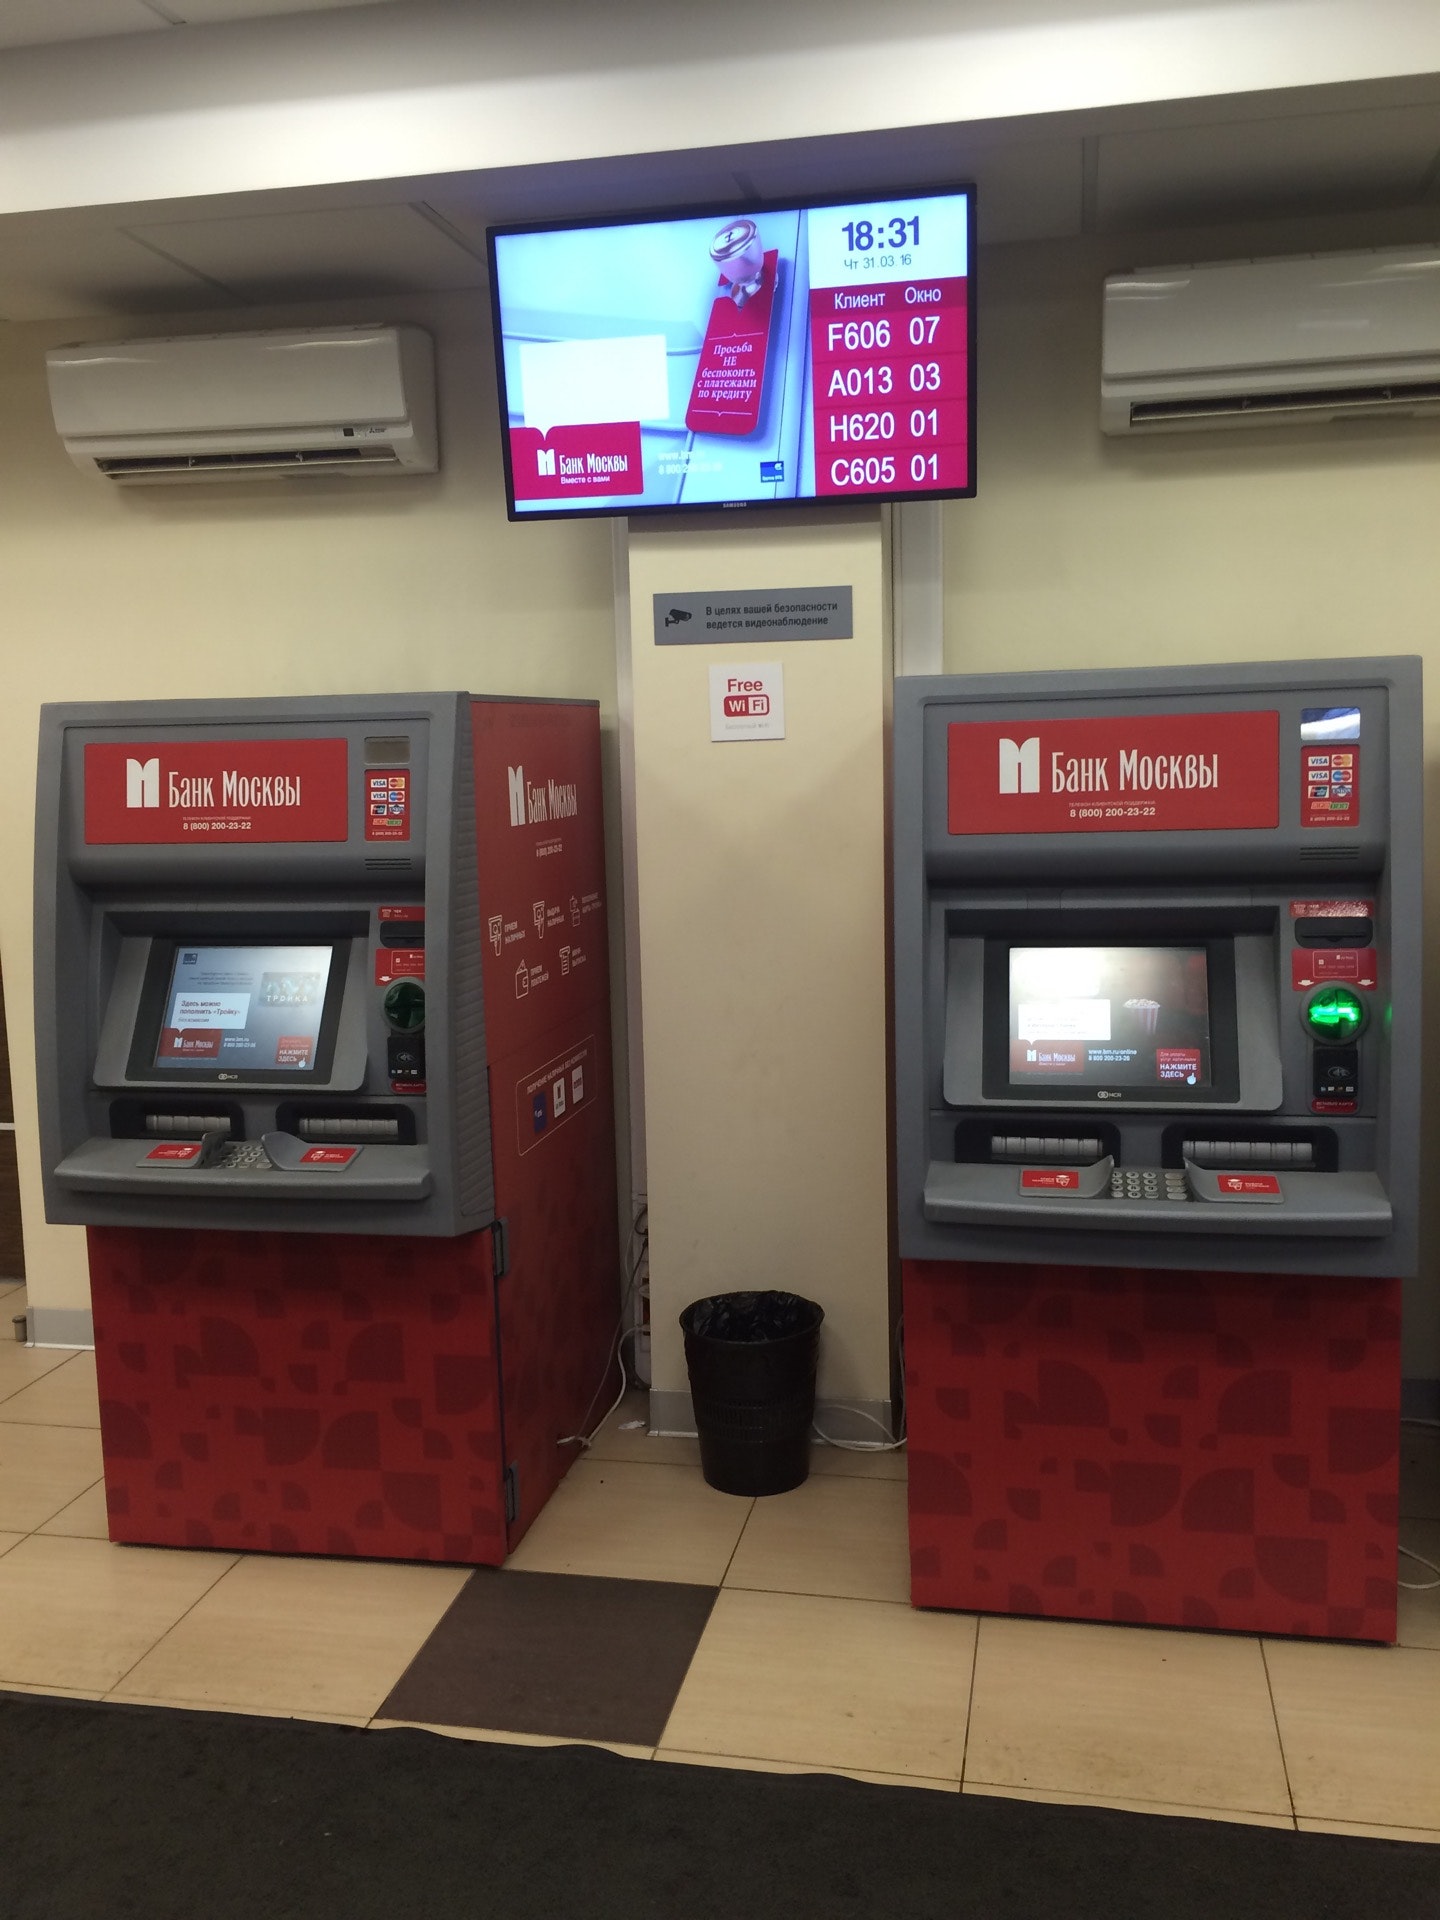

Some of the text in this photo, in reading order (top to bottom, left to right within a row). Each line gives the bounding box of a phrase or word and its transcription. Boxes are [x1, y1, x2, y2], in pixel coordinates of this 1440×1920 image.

[841, 215, 920, 252] 18:31
[843, 259, 859, 271] Чт
[834, 286, 942, 310] Клиент Окно
[828, 315, 941, 352] F606 07
[713, 341, 753, 357] Просьба
[722, 356, 737, 367] НЕ
[701, 367, 756, 378] беспокоить
[697, 379, 757, 388] с платежами
[827, 362, 941, 398] A013 03
[698, 390, 752, 402] по кредиту
[830, 408, 938, 442] H620 01
[559, 454, 584, 475] Банк
[587, 452, 628, 473] Москвы
[831, 453, 938, 486] C605 01
[560, 476, 585, 484] Вместе
[593, 474, 611, 483] вами
[706, 602, 838, 617] В целях вашей безопасности
[706, 617, 829, 630] ведется видеонаблюдение
[727, 679, 763, 692] Free
[1052, 752, 1109, 793] Банк
[1119, 749, 1218, 791] Москвы
[168, 771, 214, 808] Банк
[222, 770, 301, 807] Москвы
[526, 781, 548, 824] Банк
[547, 779, 578, 821] Москвы
[1069, 807, 1156, 819] 8 (800) 200-23-22
[183, 822, 252, 831] 8 (800) 200-23-22
[181, 1000, 199, 1008] Здесь
[278, 1055, 298, 1063] ЗДЕСЬ
[1159, 1063, 1197, 1071] НАЖМИТЕ
[1159, 1071, 1185, 1079] ЗДЕСЬ
